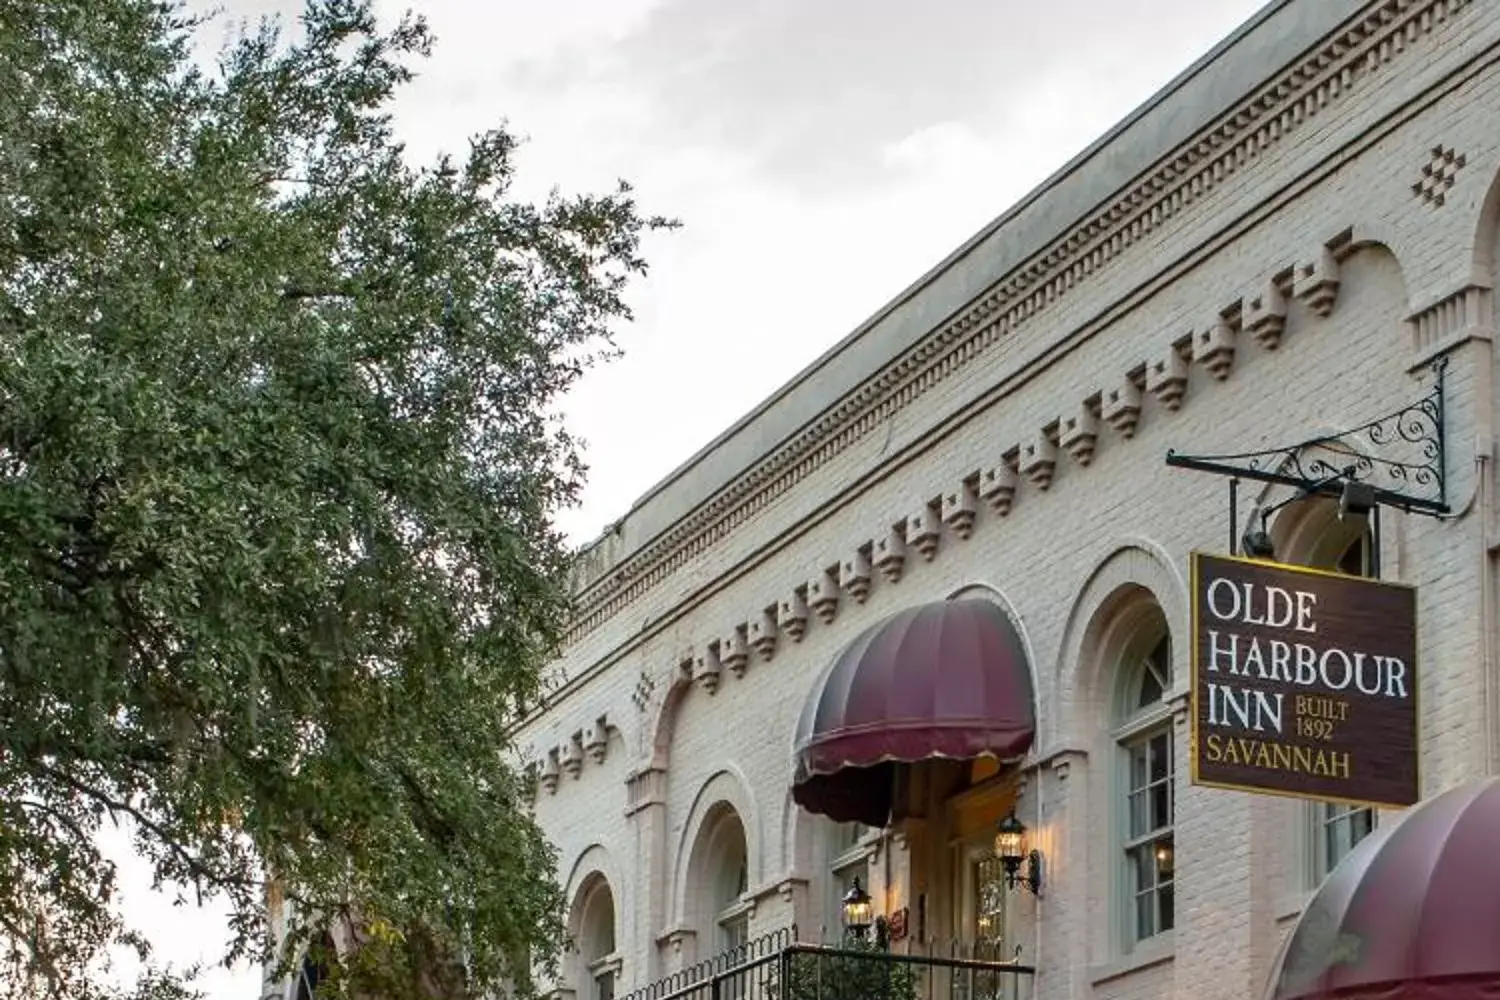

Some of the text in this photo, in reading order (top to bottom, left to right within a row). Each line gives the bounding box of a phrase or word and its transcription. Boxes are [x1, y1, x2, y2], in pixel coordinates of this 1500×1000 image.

[1207, 577, 1317, 633] OLDE
[1207, 630, 1408, 698] HARBOUR
[1207, 683, 1284, 733] INN
[1295, 695, 1349, 721] BUILT
[1296, 717, 1333, 740] 1892
[1206, 734, 1350, 779] SAVANNAH
